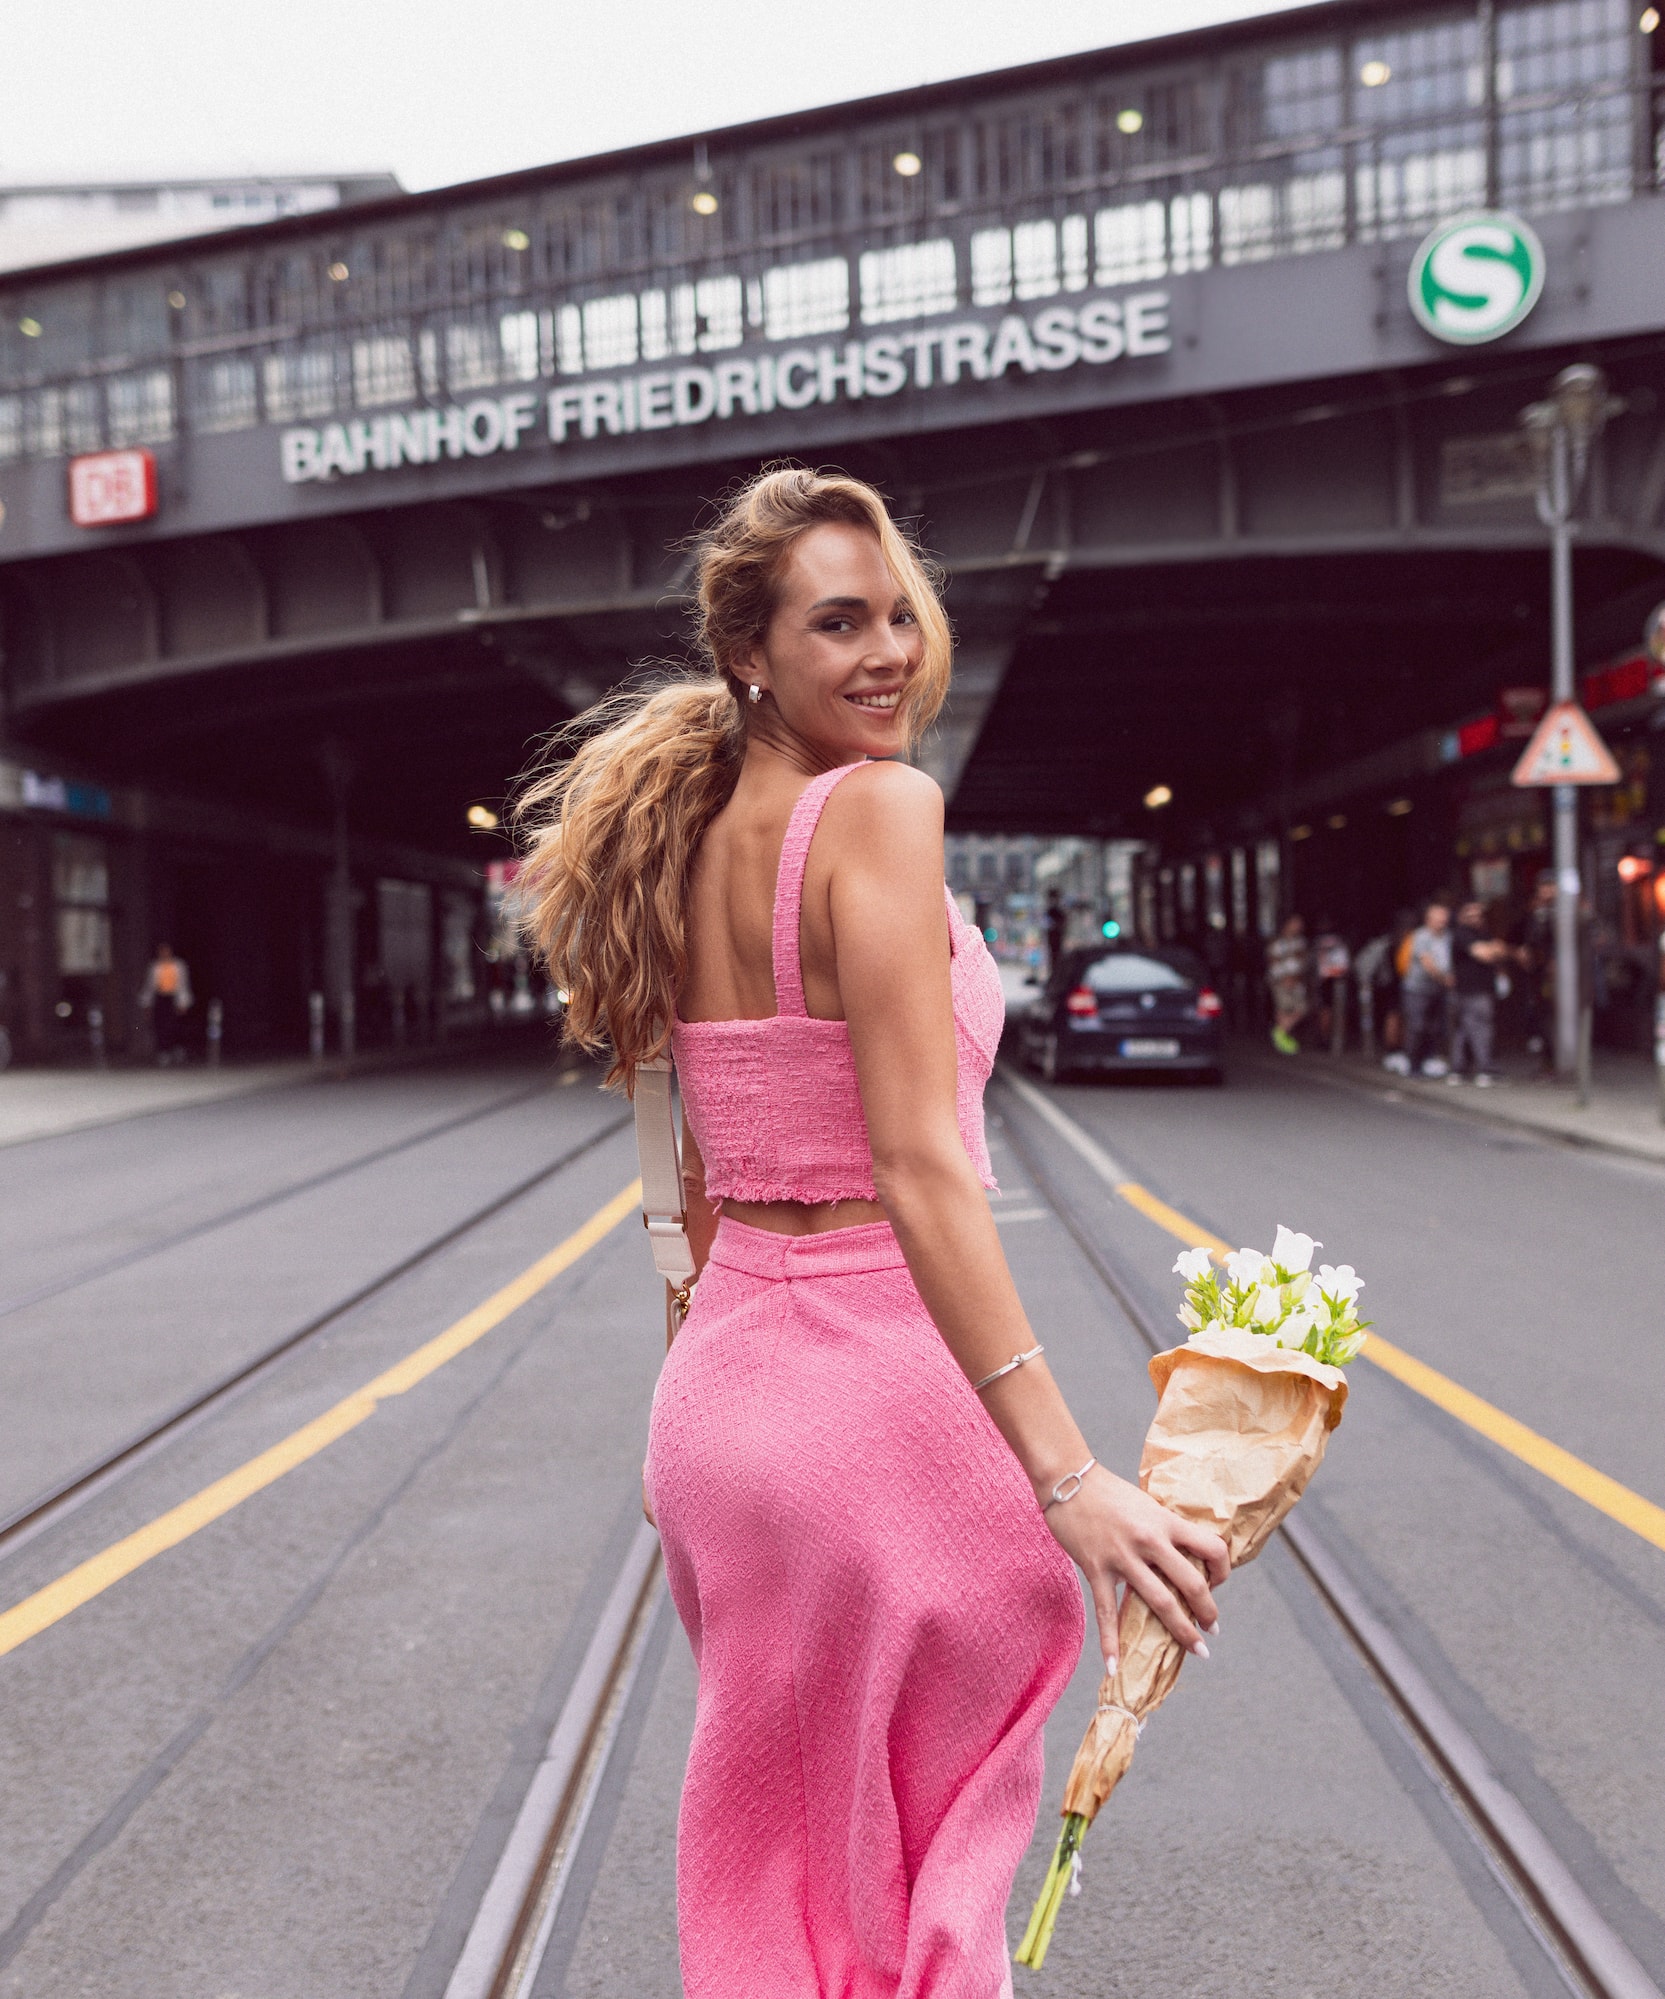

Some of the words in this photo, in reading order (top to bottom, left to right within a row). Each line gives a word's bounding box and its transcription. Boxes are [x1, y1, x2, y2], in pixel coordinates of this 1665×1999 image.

[1430, 226, 1523, 331] S
[280, 393, 538, 483] BAHNHOF
[547, 292, 1171, 443] FRIEDRICHSTRASSE
